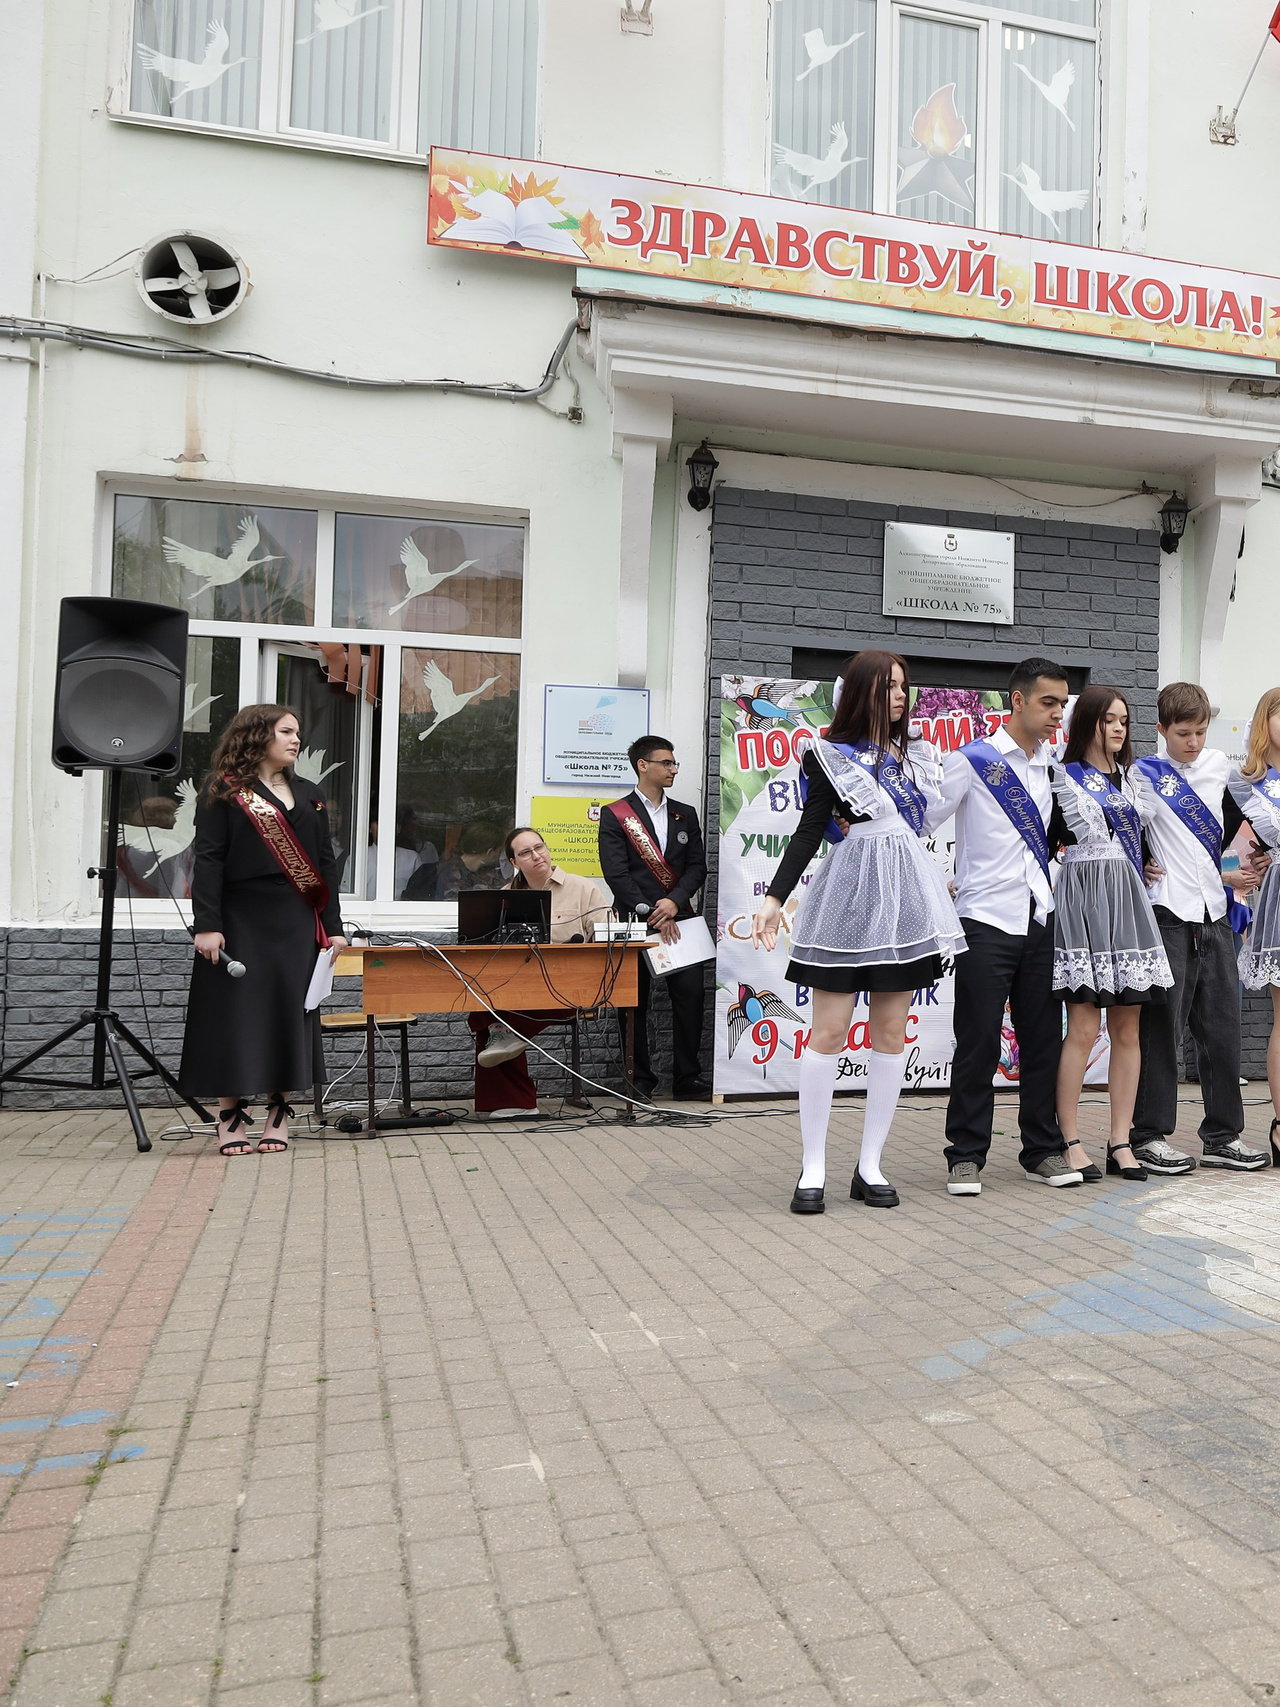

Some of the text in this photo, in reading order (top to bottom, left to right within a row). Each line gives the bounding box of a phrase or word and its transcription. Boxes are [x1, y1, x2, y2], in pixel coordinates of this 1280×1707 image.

[606, 199, 1263, 336] ЗДРАВСТВУЙ, ШКОЛА!
[898, 569, 1002, 584] МУНИЦИПАЛЬНОЕ БЮДЖЕТНОЕ
[909, 577, 990, 589] ОБЩЕОБРАЗОВАТЕЛЬНОЕ
[927, 585, 973, 594] УЧРЕЖДЕНИЕ
[896, 597, 1002, 615] «ШКОЛА № 75»
[564, 763, 628, 772] «Школа № 75»
[751, 1019, 779, 1064] 9
